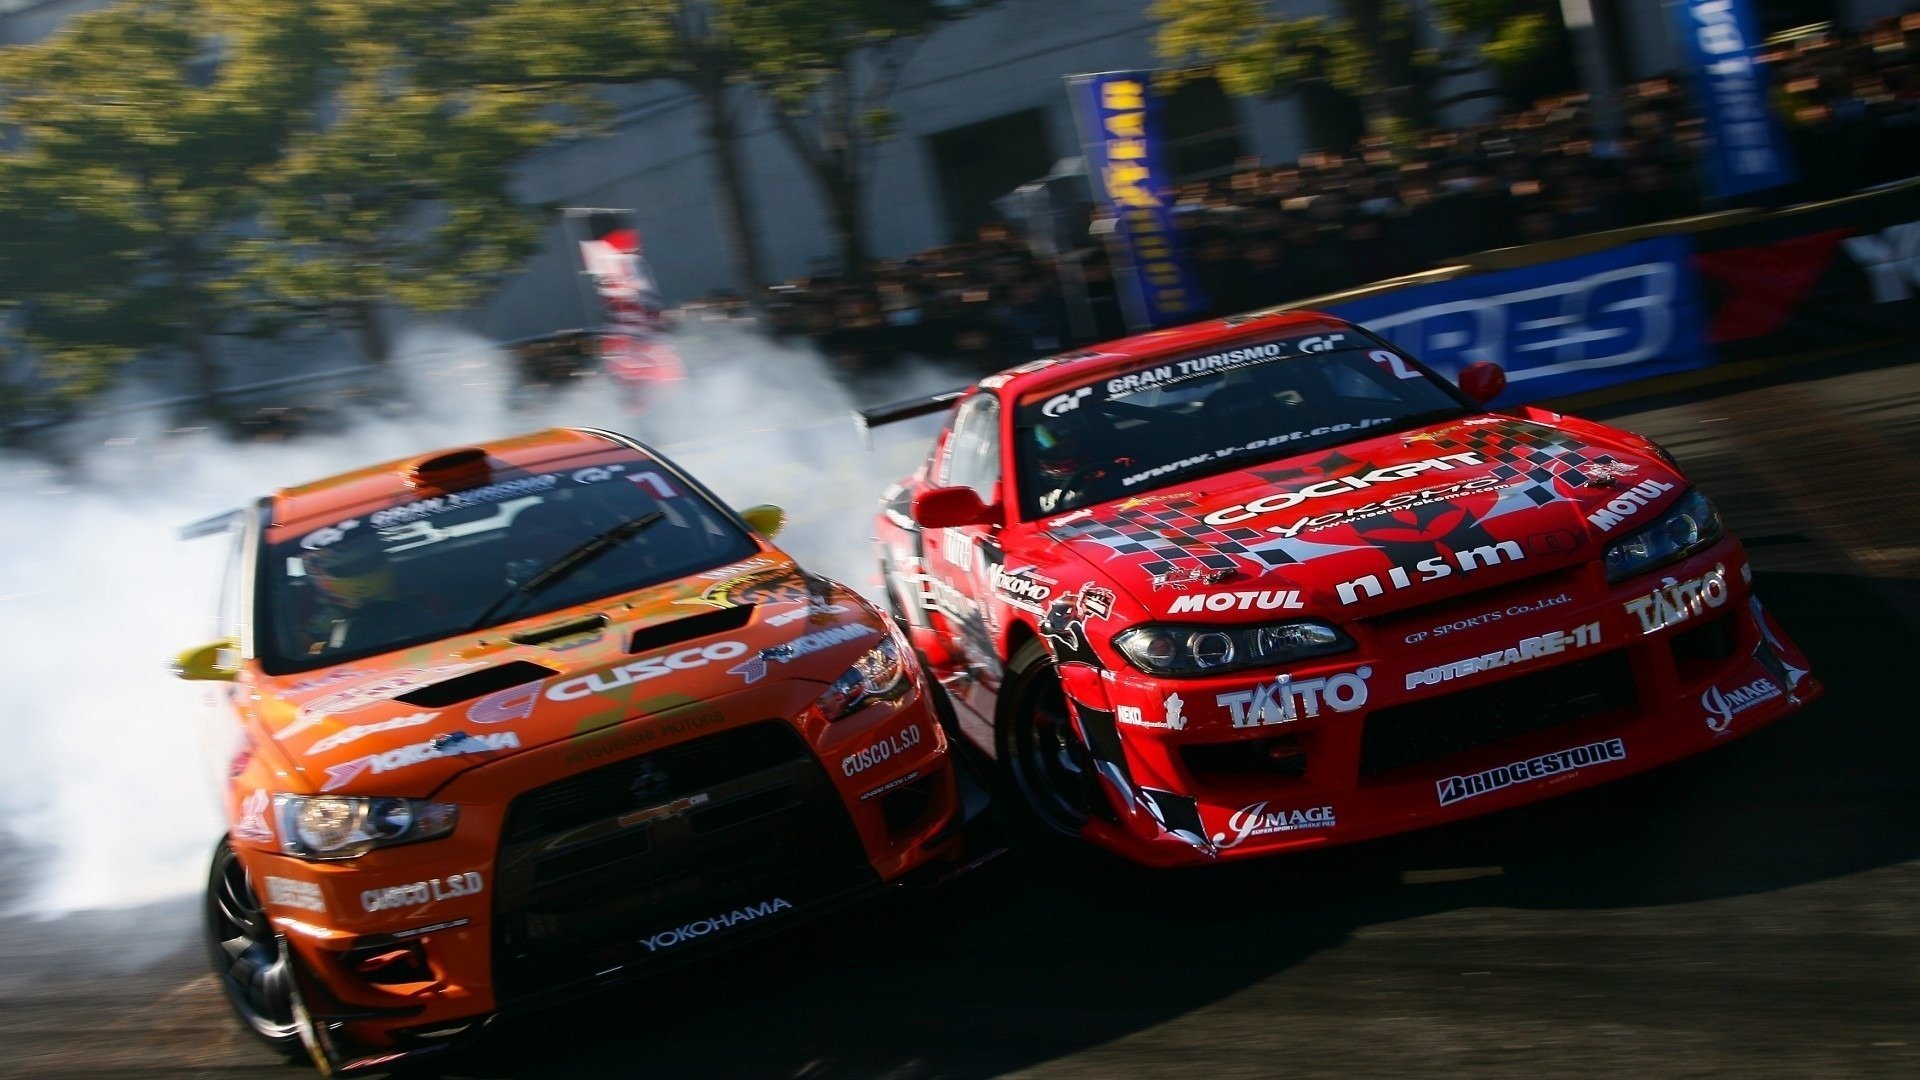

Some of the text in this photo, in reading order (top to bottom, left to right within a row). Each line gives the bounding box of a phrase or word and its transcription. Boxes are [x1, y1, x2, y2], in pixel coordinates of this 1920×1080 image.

[1106, 365, 1172, 393] GRAN
[1177, 344, 1282, 375] TURISMO
[1369, 350, 1422, 380] 2
[1203, 451, 1486, 526] COCKPIT
[1266, 478, 1500, 538] YOKOMO
[1308, 483, 1512, 533] www.teamyokomo.com
[1587, 479, 1674, 532] MOTUL
[1167, 590, 1304, 614] MOTUL
[1623, 562, 1727, 634] TAITO
[1405, 631, 1428, 644] GP
[1433, 611, 1502, 636] SPORTS
[545, 641, 748, 701] CUSCO
[1406, 648, 1523, 690] POTENZA
[1216, 666, 1373, 729] TAITO
[565, 711, 725, 766] MITSUBISHI MOTORS
[842, 724, 920, 777] CUSCO L.S.D
[1436, 738, 1627, 806] BRIDGESTONE
[1251, 828, 1273, 836] SUPER
[360, 881, 429, 913] CUSCO
[640, 897, 793, 952] YOKOHAMA
